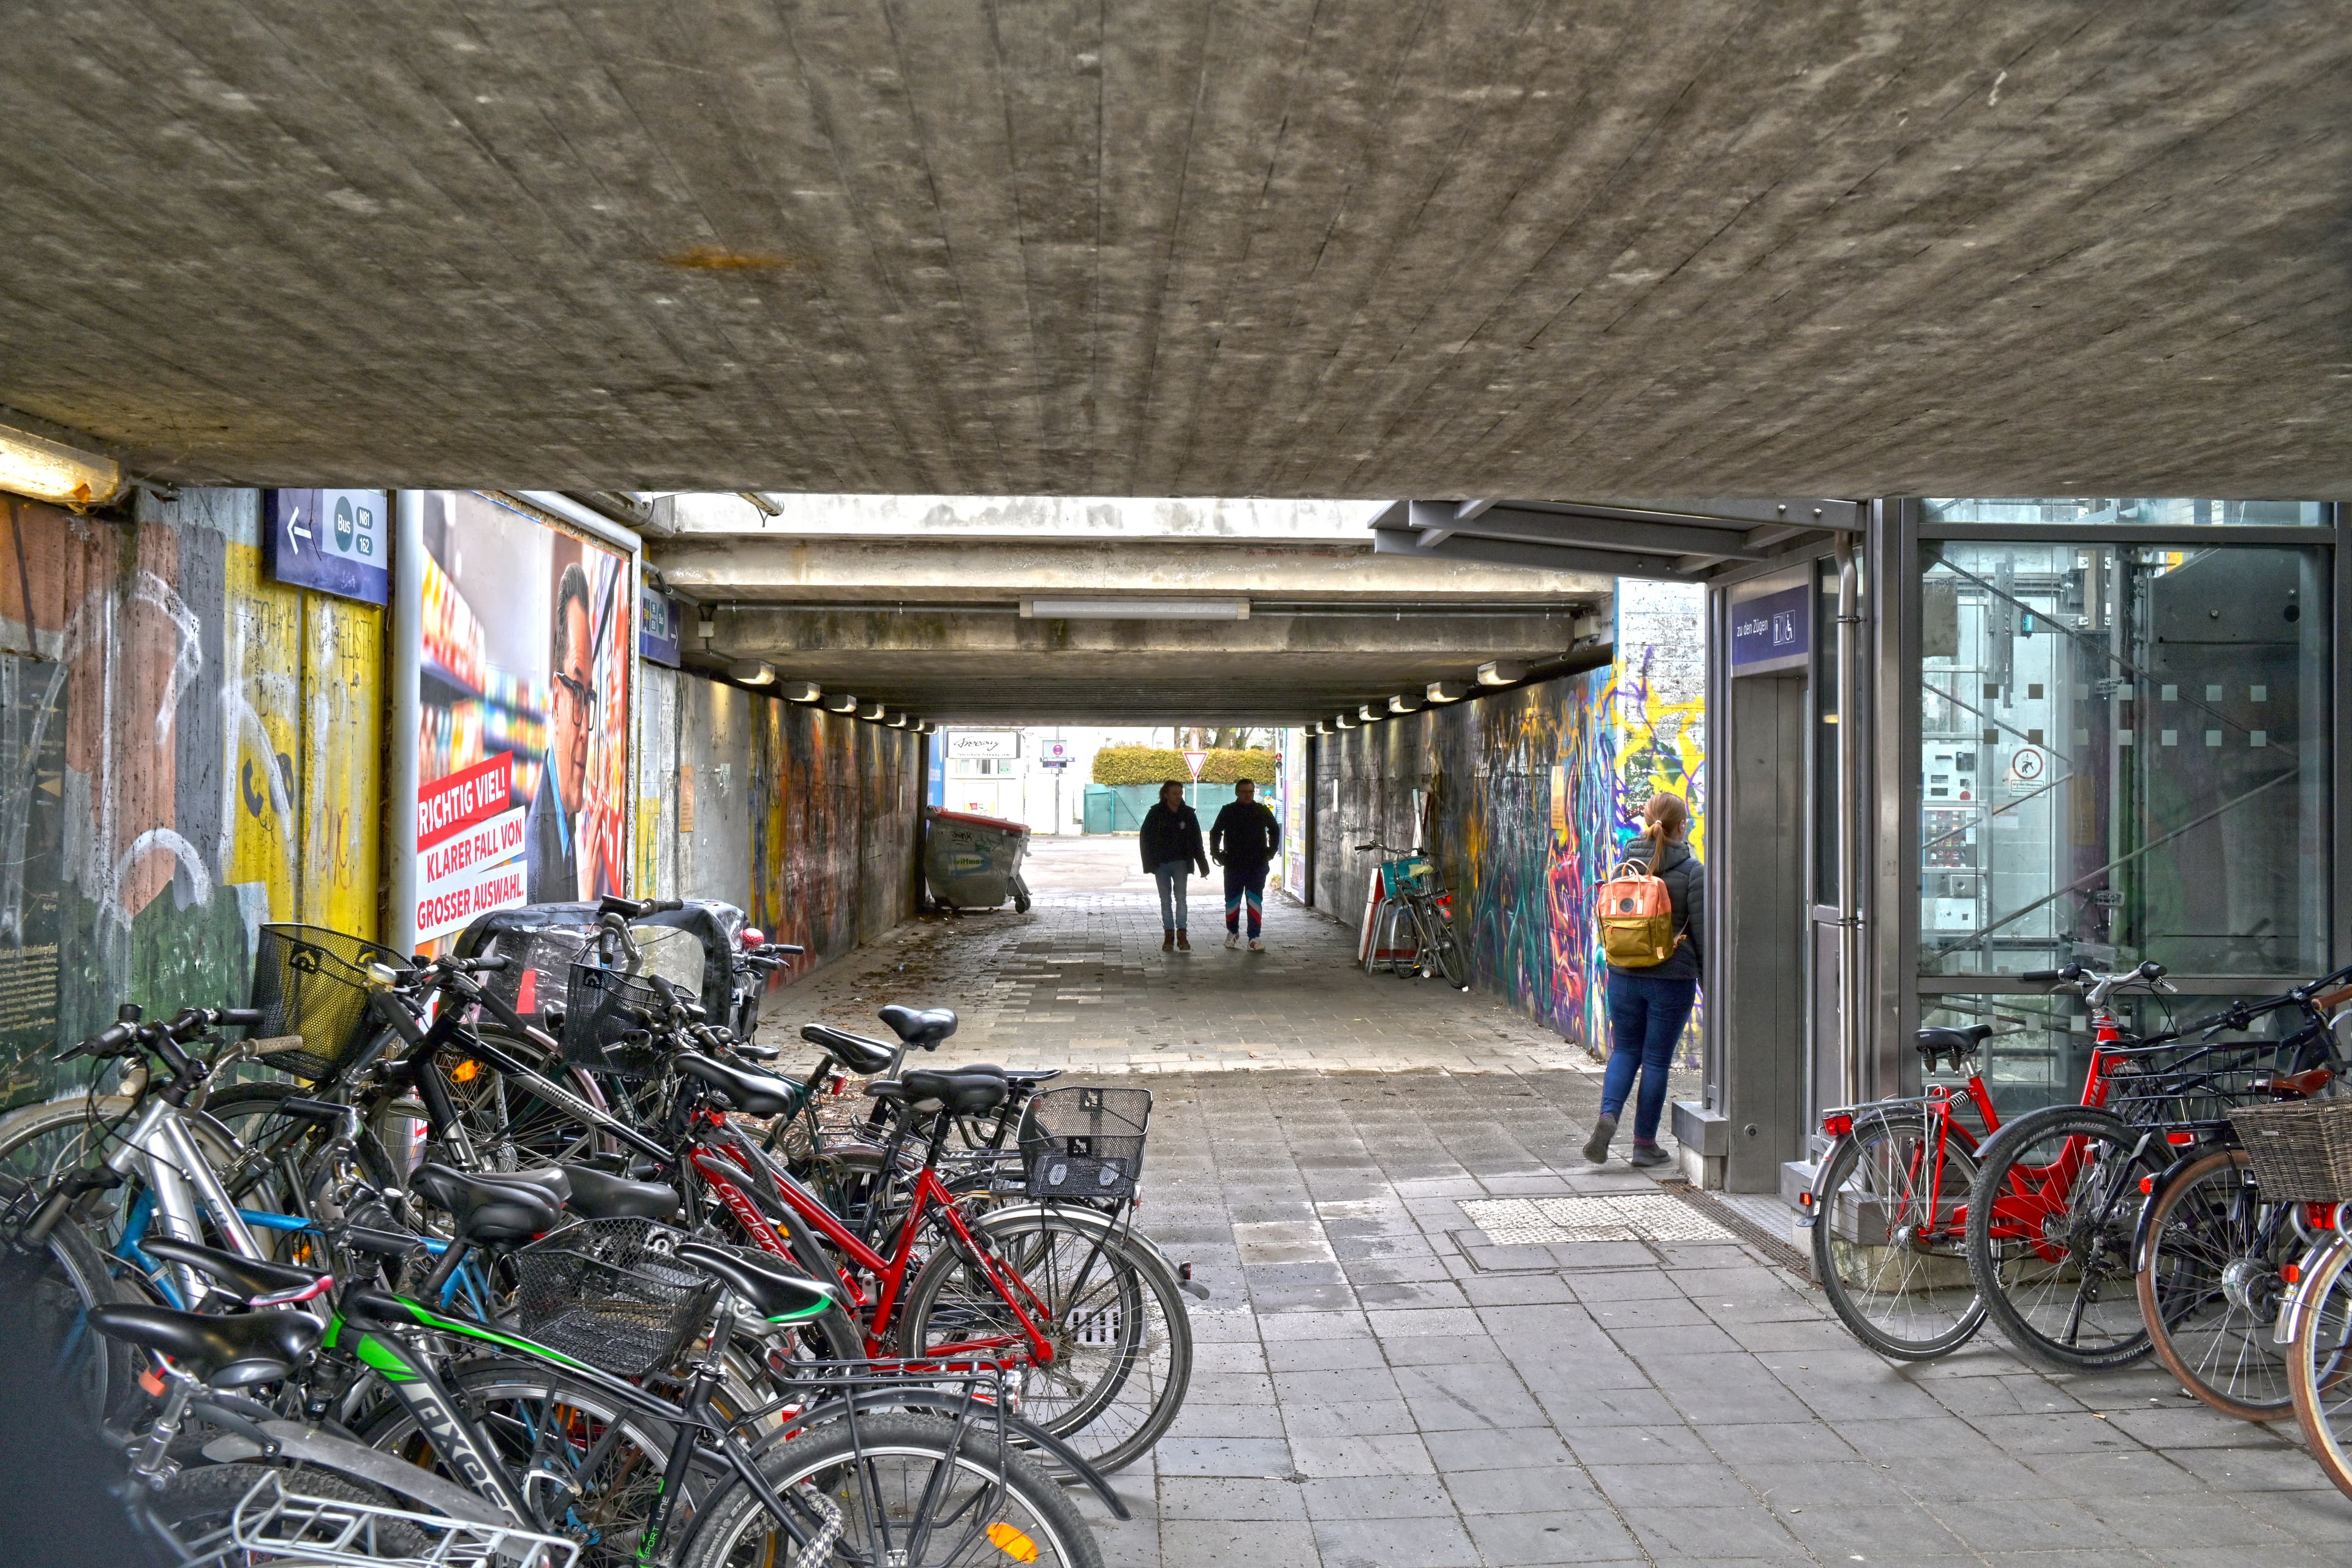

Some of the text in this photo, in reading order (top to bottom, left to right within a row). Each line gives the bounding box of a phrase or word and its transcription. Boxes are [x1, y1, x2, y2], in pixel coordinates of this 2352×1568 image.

[338, 514, 351, 534] Bus
[359, 509, 370, 527] N81
[359, 537, 370, 554] 162
[1737, 619, 1768, 637] zu den Zügen
[418, 766, 505, 837] RICHTIG VIEL!
[427, 818, 522, 883] KLARER FALL VON
[417, 873, 524, 930] GROSSER AUSWAHL.
[718, 1183, 787, 1261] Gudere
[2082, 1339, 2154, 1364] CHWALBE
[643, 1495, 671, 1559] SPORT LINE
